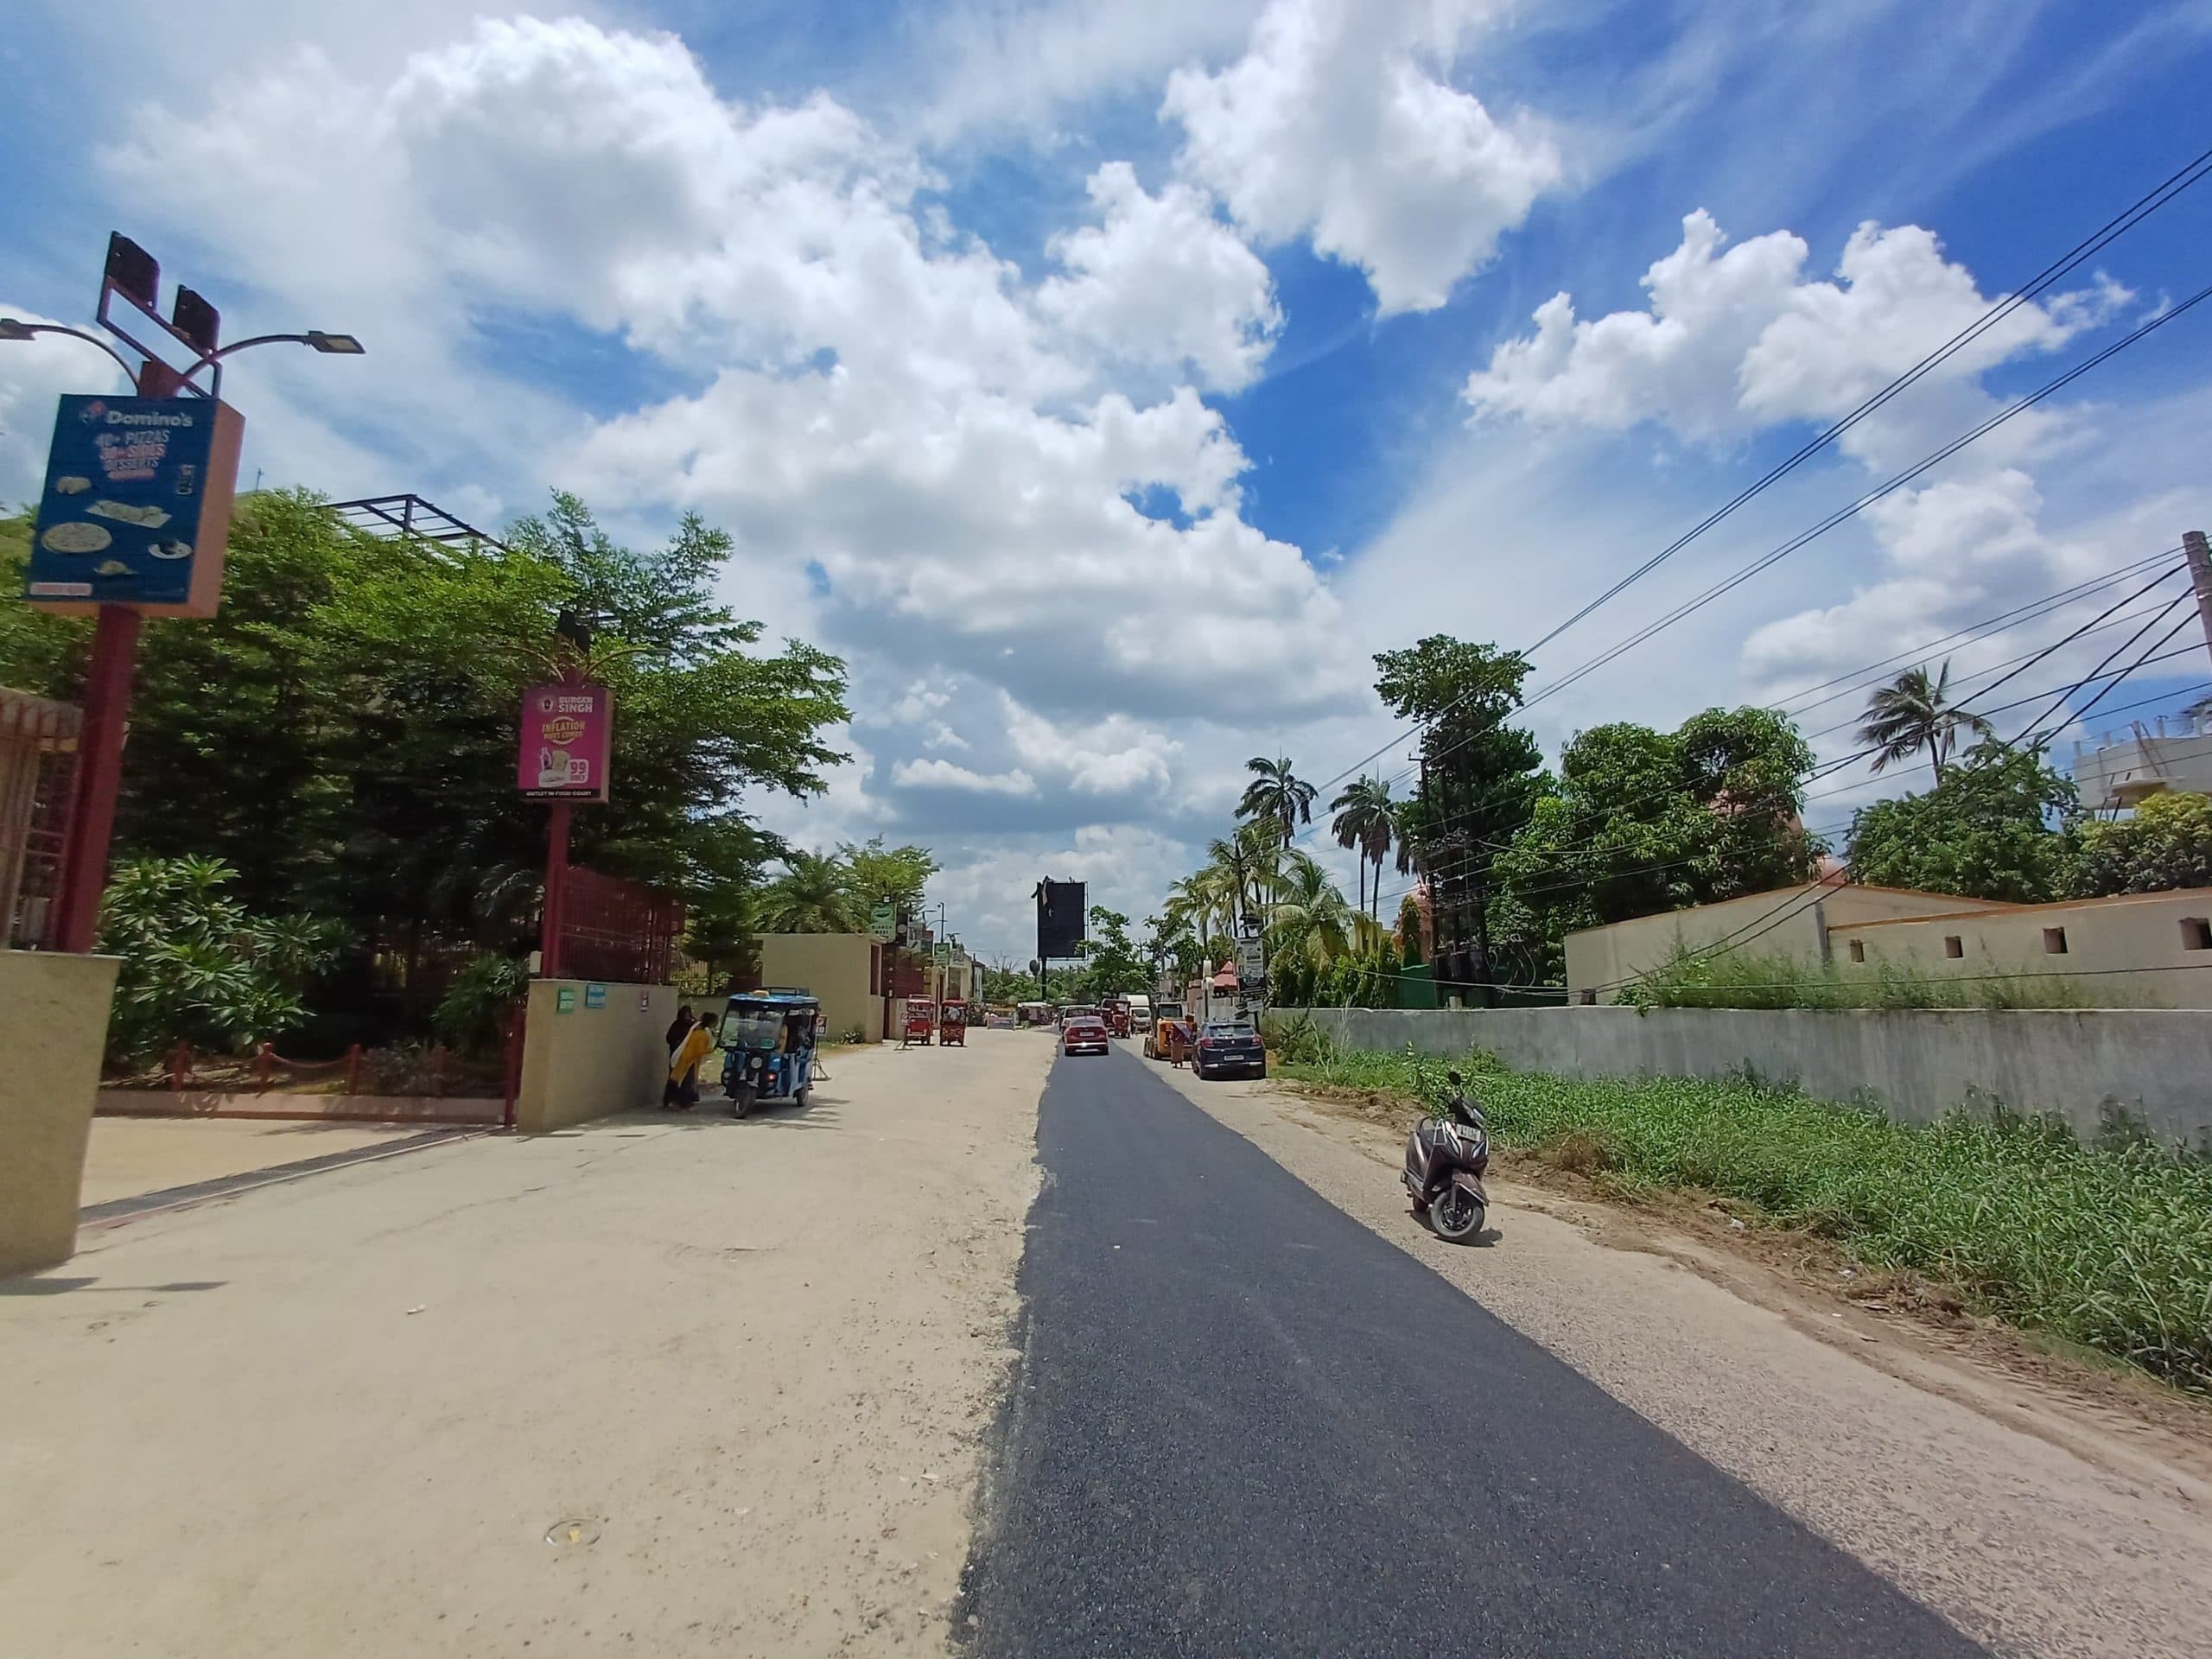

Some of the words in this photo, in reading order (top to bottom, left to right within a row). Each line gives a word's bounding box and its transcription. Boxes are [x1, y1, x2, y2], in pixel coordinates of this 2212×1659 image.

[105, 410, 194, 428] Domino's
[124, 429, 171, 445] PIZZAS
[558, 703, 594, 713] SINGH
[570, 761, 587, 774] 99
